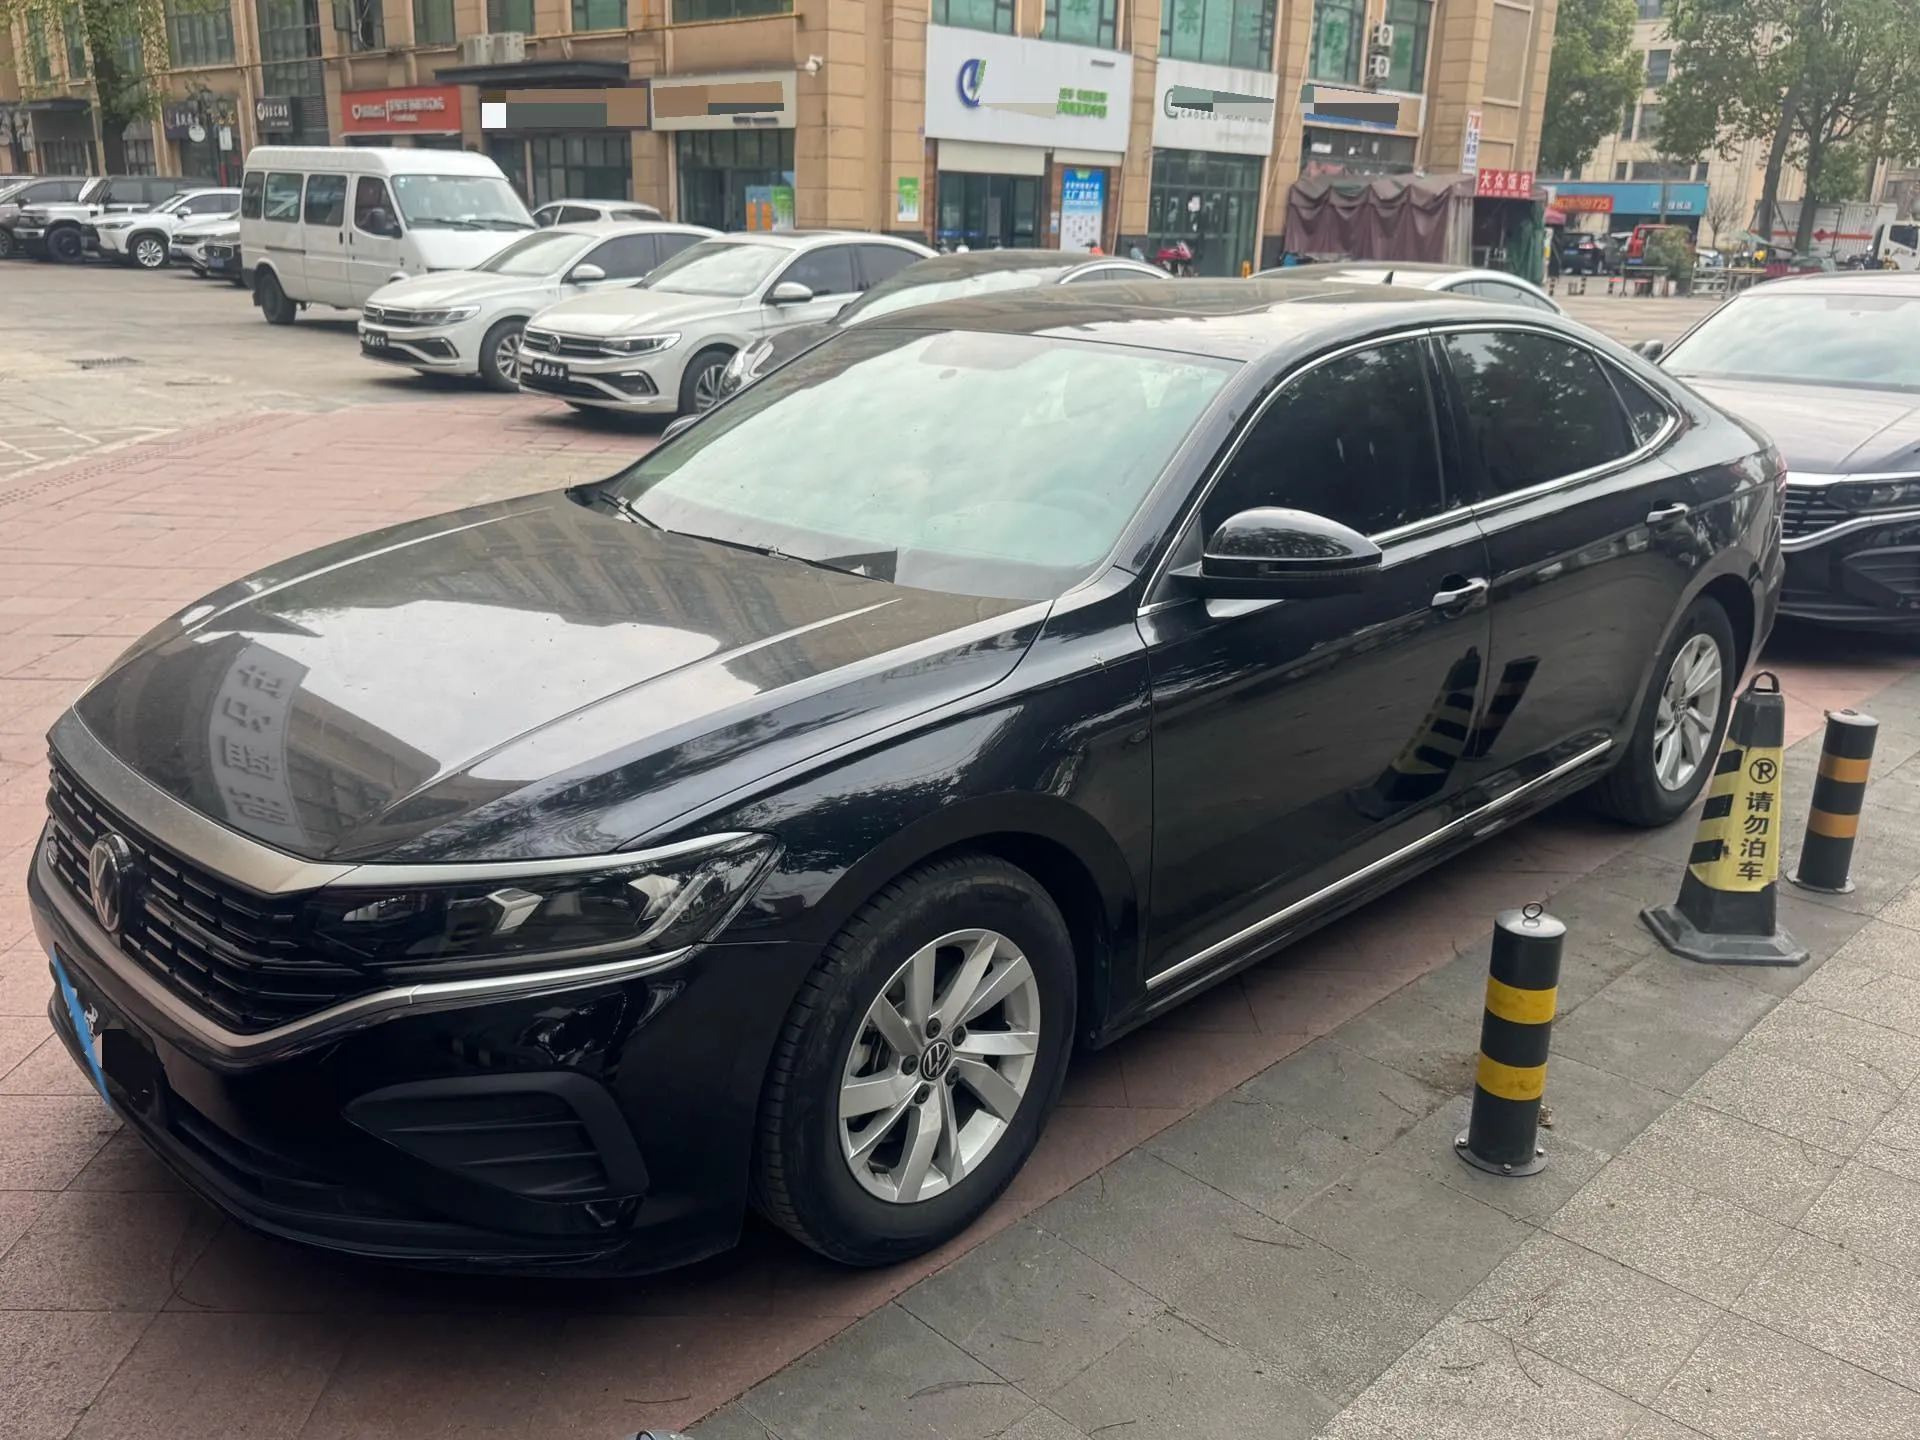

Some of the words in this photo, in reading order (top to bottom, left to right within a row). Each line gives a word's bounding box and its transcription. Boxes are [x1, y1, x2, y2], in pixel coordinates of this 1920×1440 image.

[1480, 171, 1530, 192] 大众饭店
[1736, 791, 1774, 881] 请勿泊车
